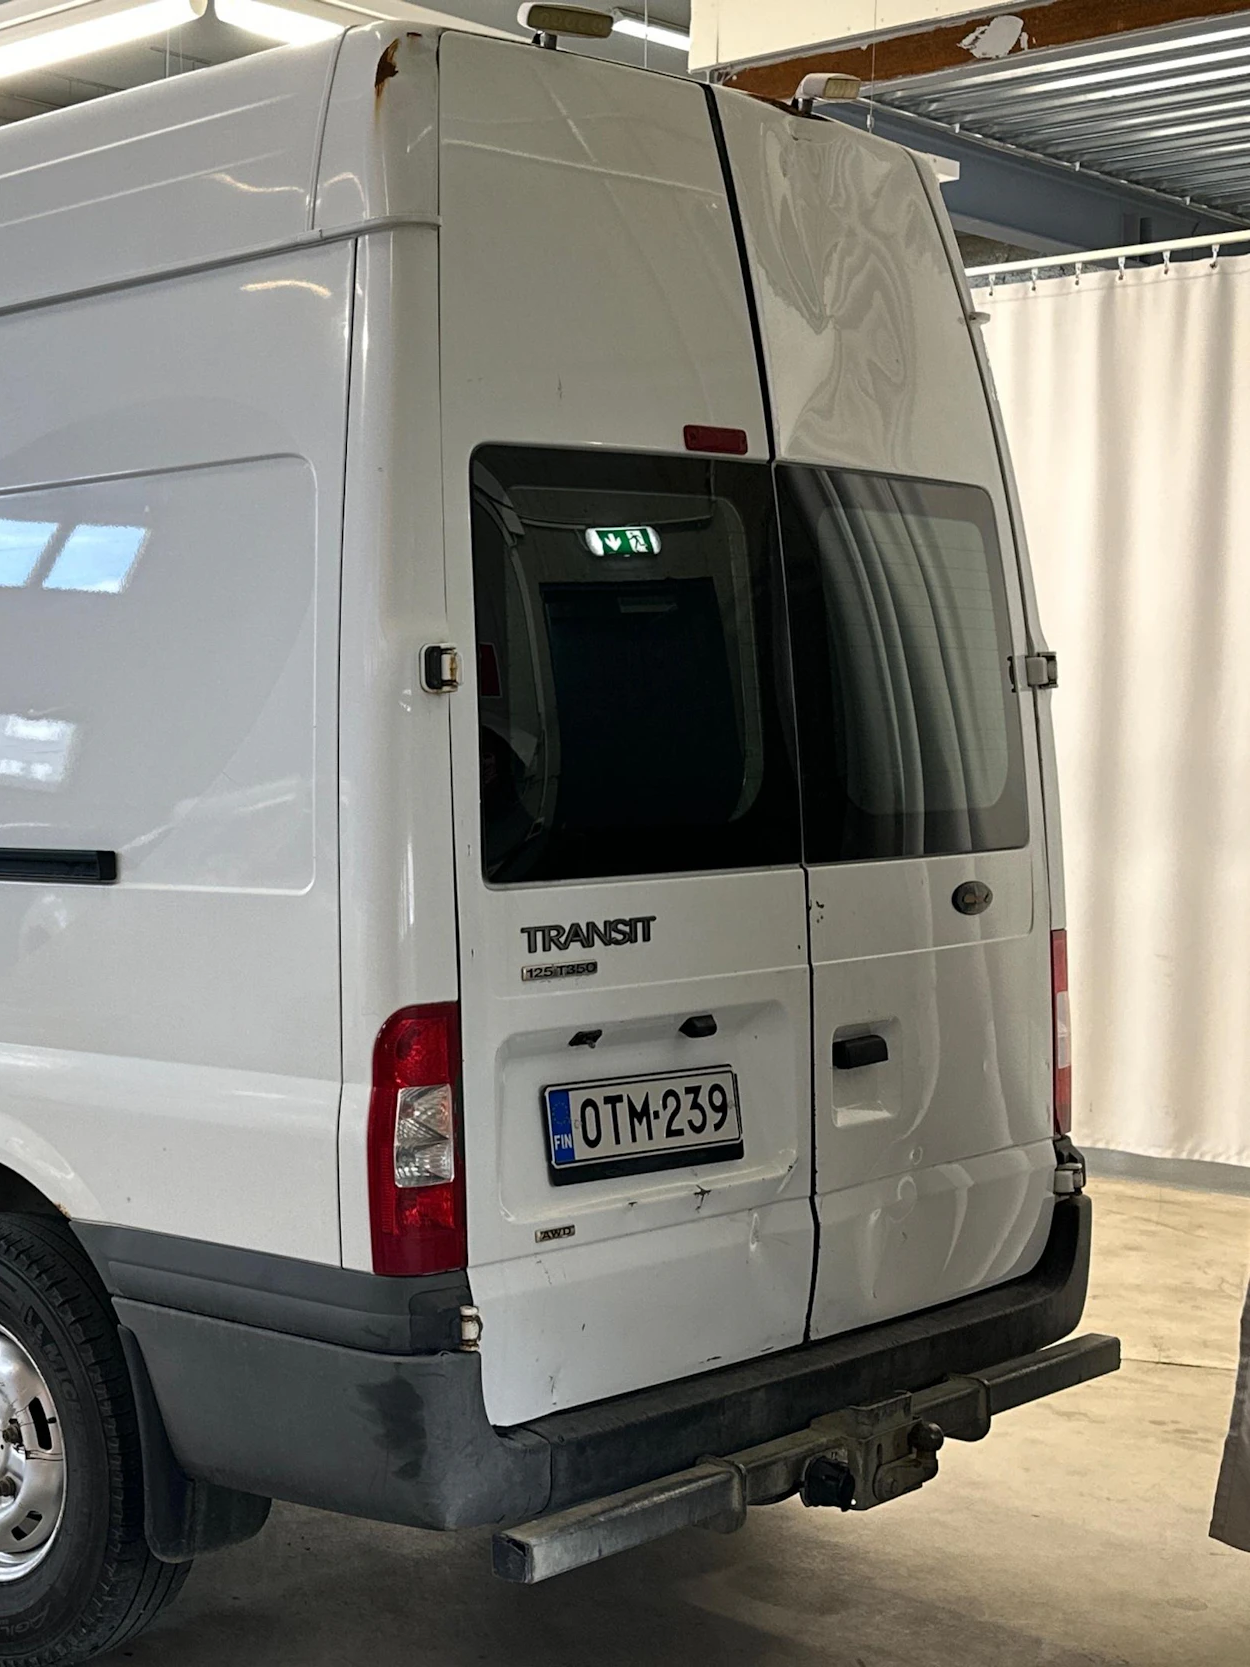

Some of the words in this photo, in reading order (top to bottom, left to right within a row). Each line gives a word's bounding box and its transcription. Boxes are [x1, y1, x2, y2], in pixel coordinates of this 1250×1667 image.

[520, 915, 657, 953] TRANSIT
[527, 966, 553, 979] 125
[557, 962, 597, 976] T350
[580, 1083, 728, 1149] OTM-239
[554, 1134, 573, 1150] FIN
[541, 1227, 571, 1240] AWD
